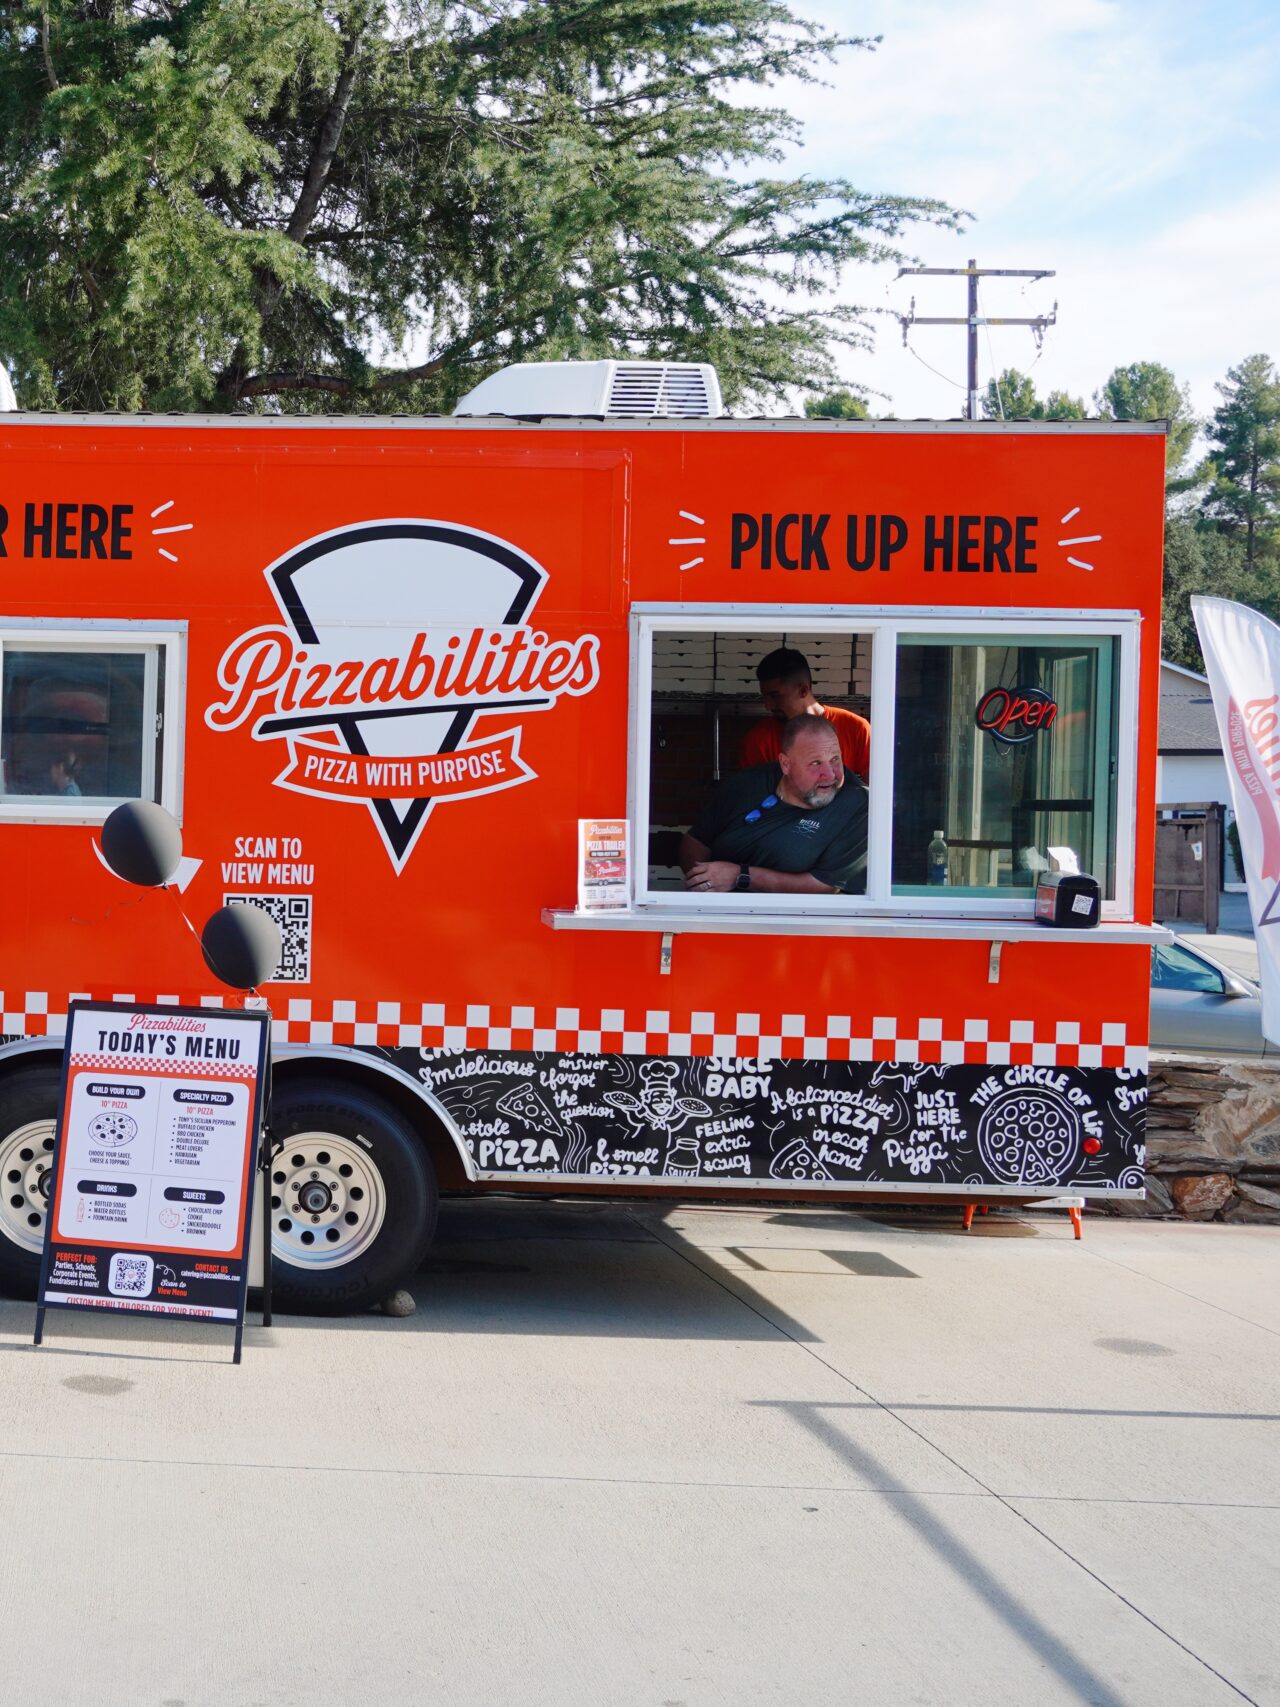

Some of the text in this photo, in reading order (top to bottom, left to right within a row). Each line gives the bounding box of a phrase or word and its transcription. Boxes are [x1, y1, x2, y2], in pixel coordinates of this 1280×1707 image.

[23, 503, 134, 560] HERE
[731, 513, 1038, 574] PICK UP HERE
[208, 627, 596, 728] Pizzabilities
[978, 689, 1058, 732] Open
[303, 749, 507, 787] PIZZA WITH PURPOSE
[234, 837, 302, 859] SCAN TO
[221, 863, 314, 885] VIEW MENU
[127, 1013, 208, 1033] Pizzabilities
[98, 1030, 241, 1059] TODAY'S MENU
[92, 1086, 109, 1094] BUILD
[110, 1087, 125, 1095] YOUR
[705, 1074, 772, 1099] BABY
[180, 1092, 227, 1103] SPECIALTY PIZZA
[112, 1101, 128, 1109] PIZZA
[197, 1107, 214, 1115] PIZZA
[109, 1158, 130, 1166] TOPPINGS
[174, 1158, 201, 1166] VEGETARIAN
[96, 1184, 118, 1193] DRINKS
[182, 1191, 206, 1200] SWEETS
[93, 1214, 114, 1222] FOUNTAIN
[186, 1221, 222, 1230] SNICKERDOODLE
[186, 1228, 206, 1236] BROWNIE
[55, 1252, 82, 1263] PERFECT
[55, 1261, 97, 1273] Parties, Schools,
[195, 1263, 229, 1273] CONTACT US
[53, 1269, 97, 1280] Corporate Events,
[48, 1276, 100, 1288] Fundraisers more!
[160, 1278, 179, 1288] Scan
[157, 1287, 188, 1297] View Menu
